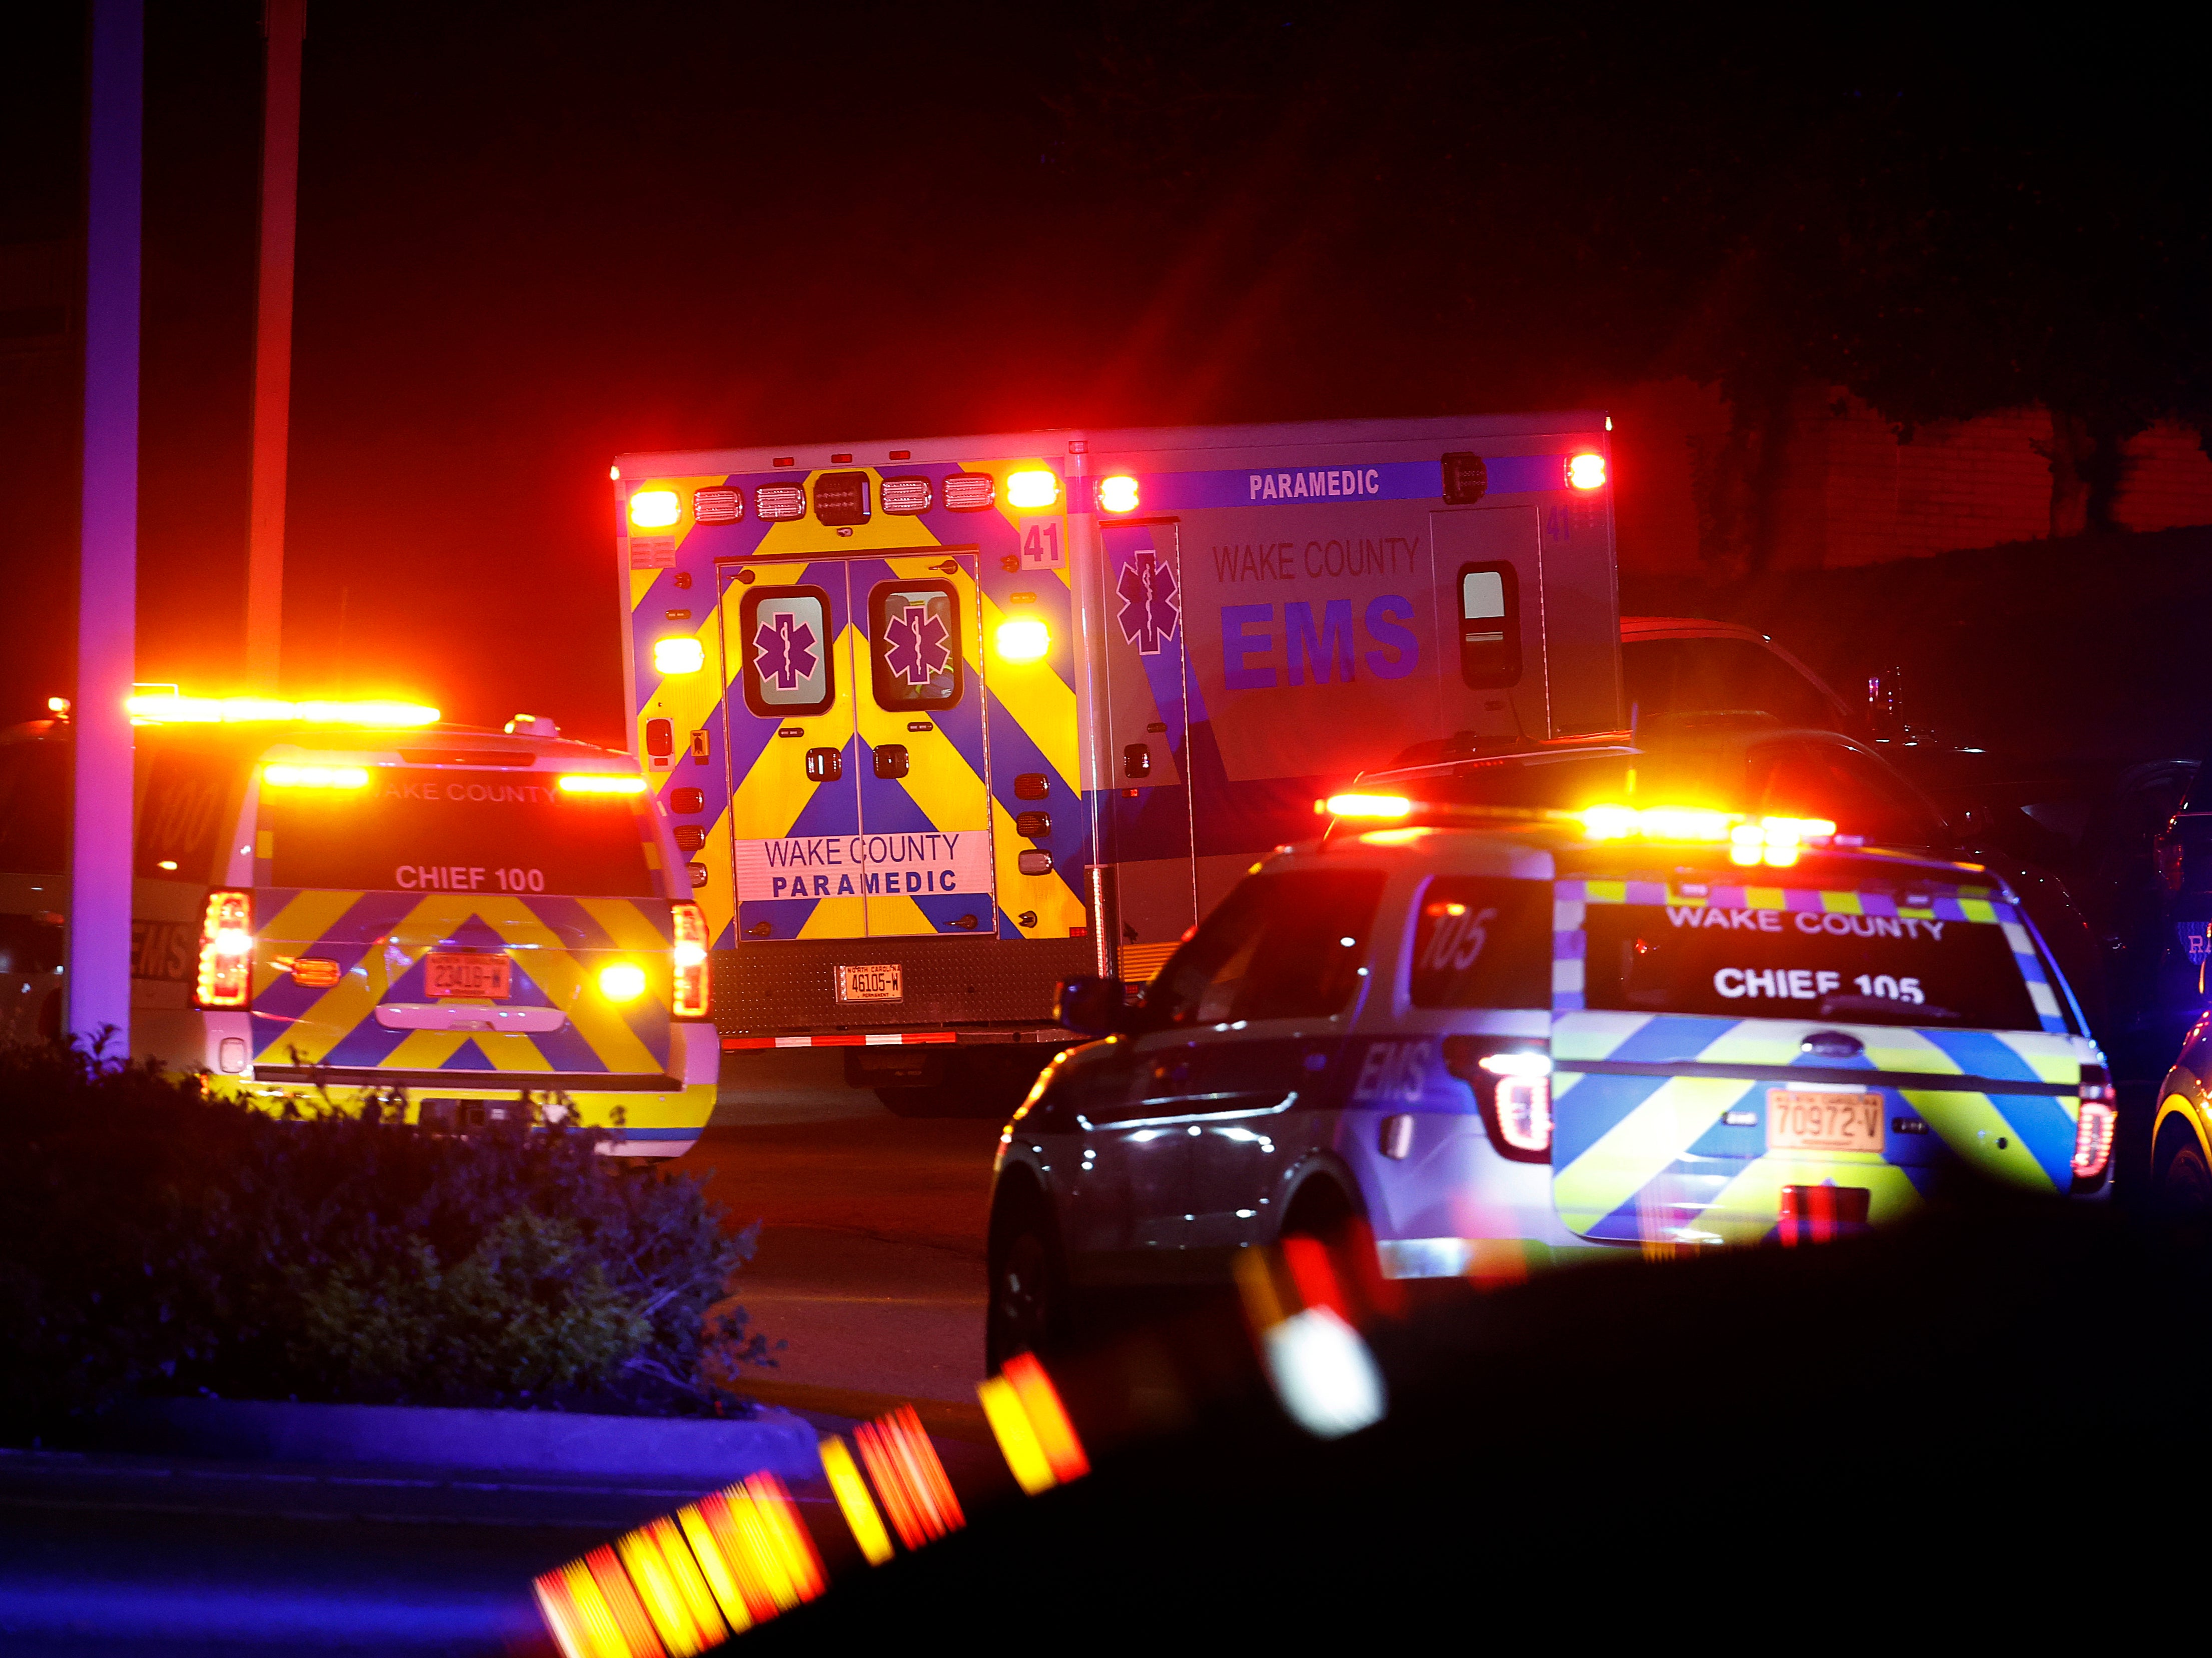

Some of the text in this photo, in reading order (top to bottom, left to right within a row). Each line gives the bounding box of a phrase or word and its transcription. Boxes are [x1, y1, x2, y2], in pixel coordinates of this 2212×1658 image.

[1250, 469, 1379, 499] PARAMEDIC
[1546, 505, 1570, 542] 41
[1024, 523, 1058, 562] 41
[1212, 536, 1419, 582] WAKE COUNTY
[1221, 594, 1419, 690] EMS
[375, 783, 557, 803] AKE COUNTY
[765, 834, 959, 867] WAKE COUNTY
[396, 865, 544, 892] CHIEF 100
[773, 870, 956, 898] PARAMEDIC
[1422, 906, 1497, 970] 105
[1666, 906, 1944, 941] WAKE COUNTY
[852, 973, 898, 992] 46105-W
[1714, 968, 1840, 999] CHIEF
[1354, 1041, 1430, 1102] EMS
[1776, 1104, 1879, 1138] 70972-V
